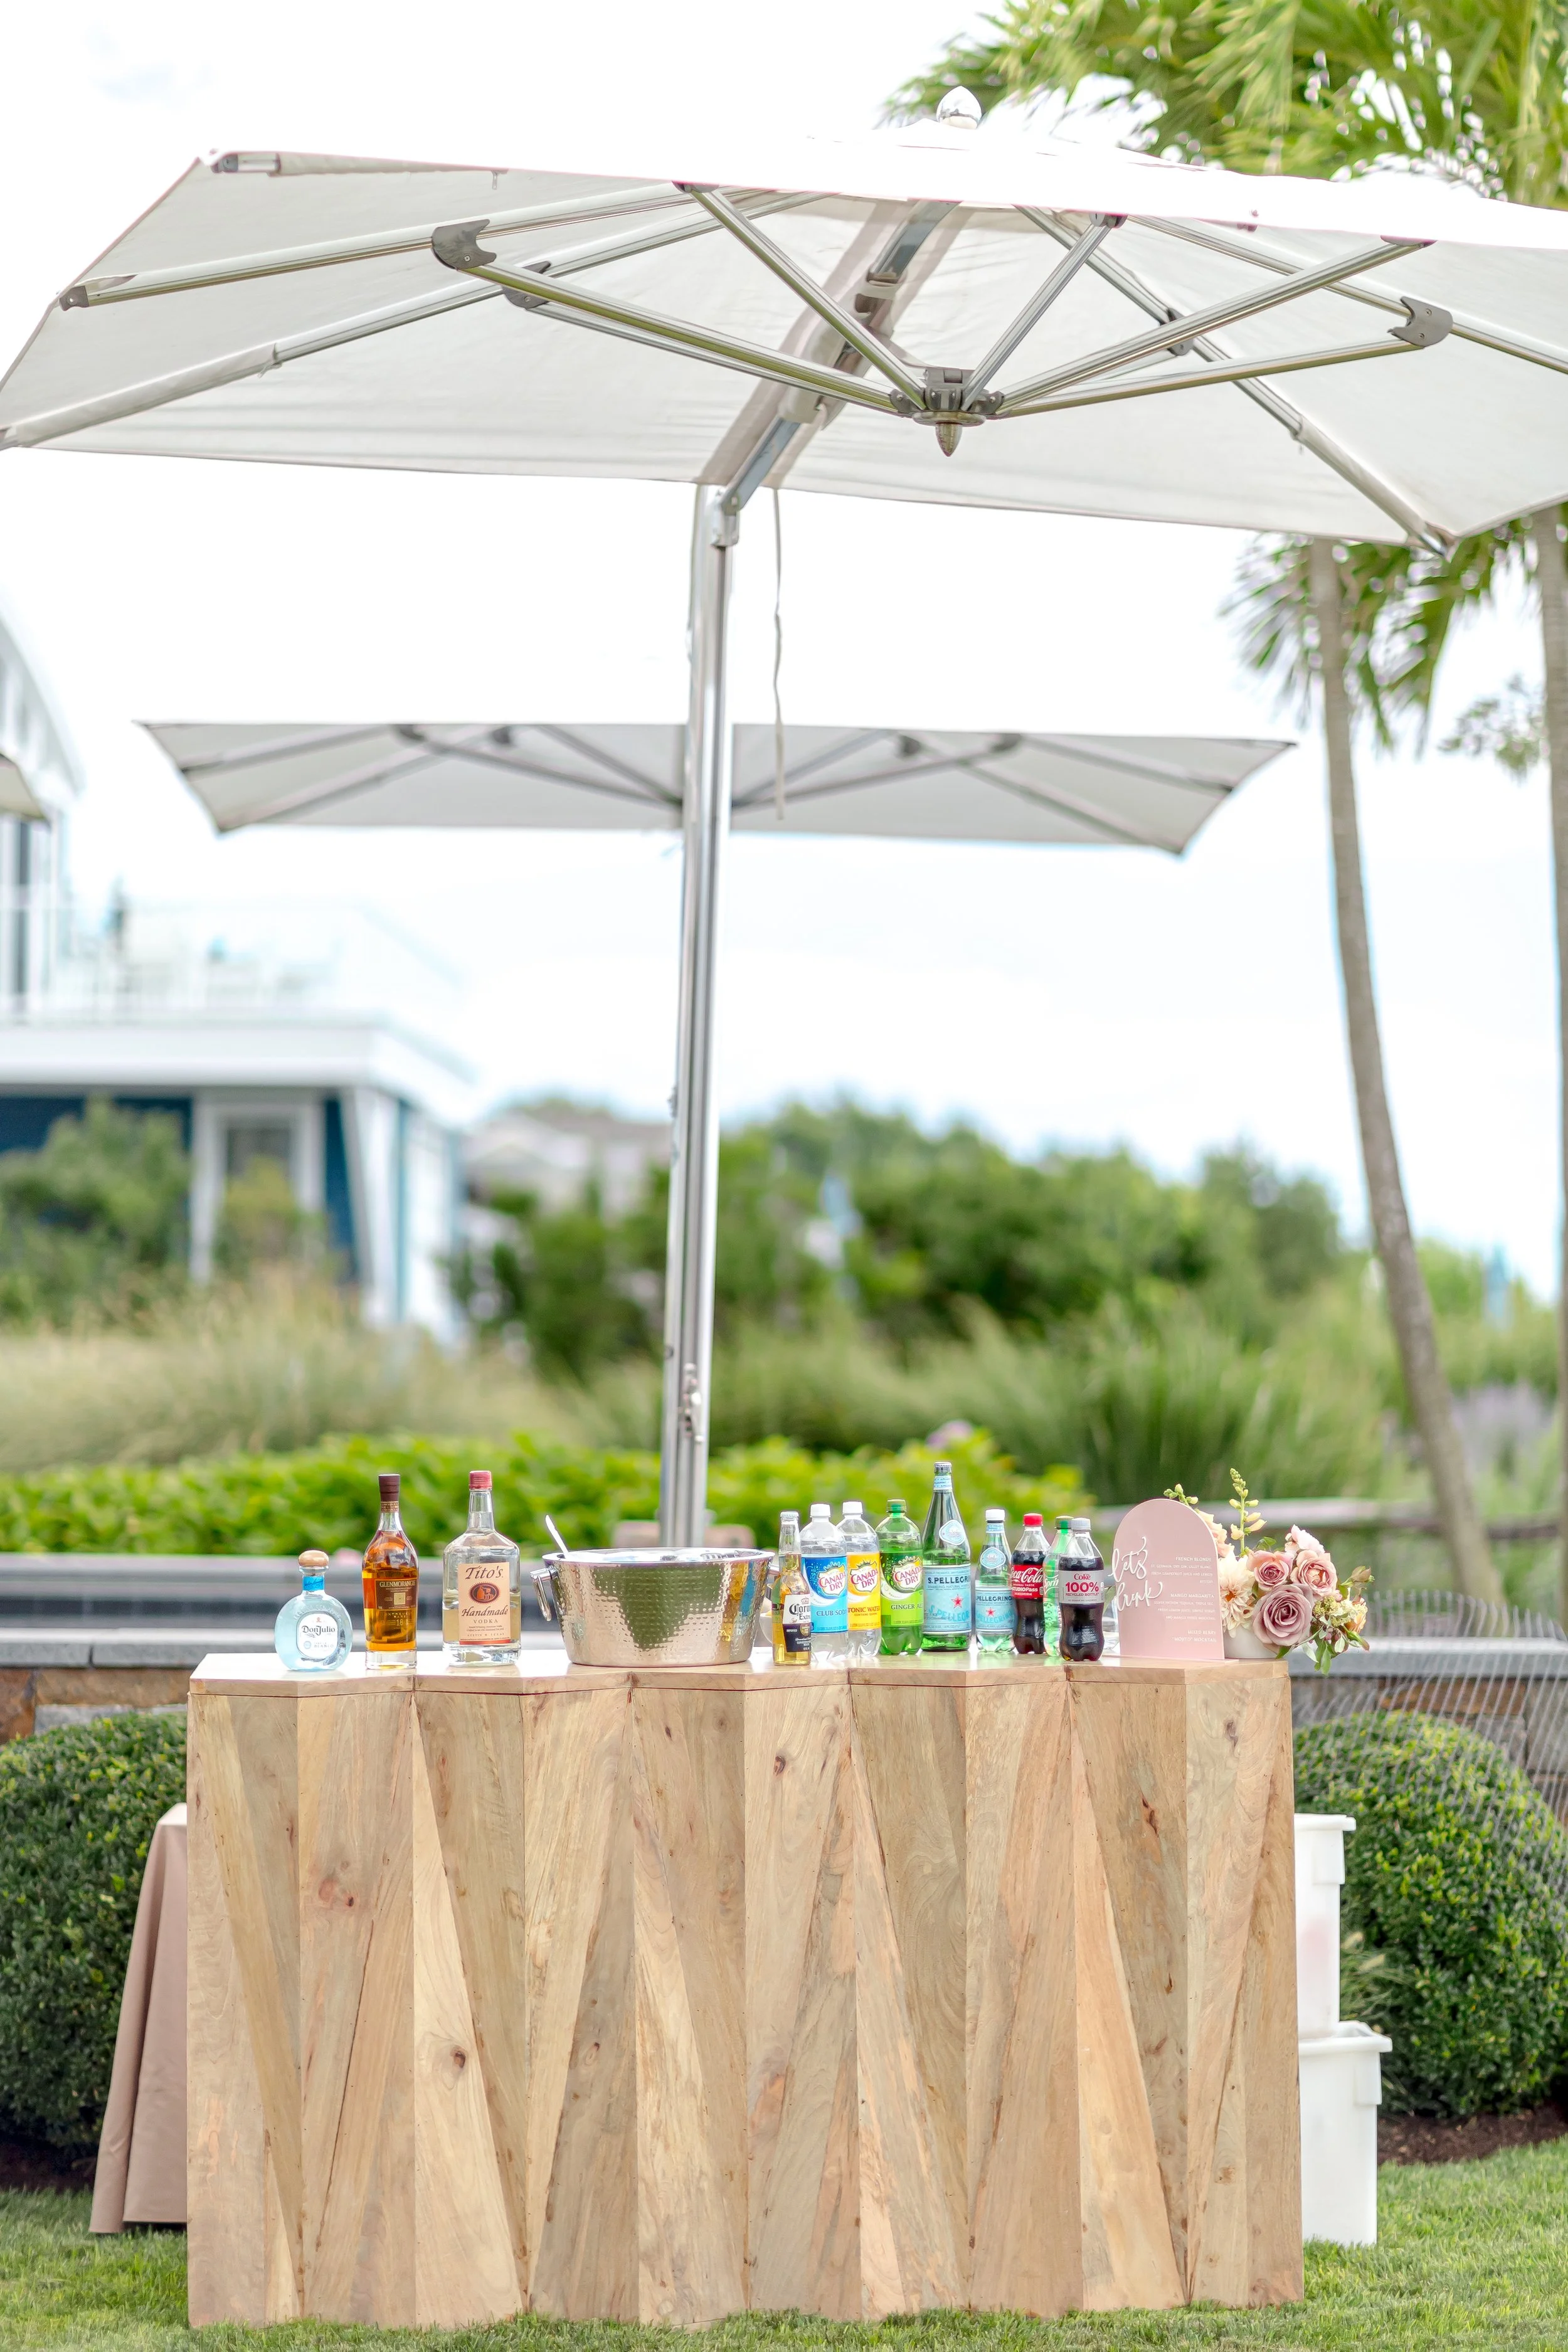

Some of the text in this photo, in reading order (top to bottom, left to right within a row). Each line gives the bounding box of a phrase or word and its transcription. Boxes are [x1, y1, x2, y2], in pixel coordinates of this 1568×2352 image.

[465, 1565, 504, 1579] Tito's
[850, 1569, 878, 1585] CANADA
[1011, 1567, 1044, 1583] ca-Cola
[829, 1581, 844, 1591] DRY
[861, 1577, 876, 1588] DRY
[905, 1576, 919, 1585] DRY
[928, 1576, 970, 1584] S.PELLEGR
[1044, 1577, 1059, 1589] Sprit
[1066, 1581, 1099, 1592] 100%
[1113, 1579, 1163, 1611] drink
[462, 1604, 509, 1616] Handmade
[788, 1603, 811, 1616] Coro
